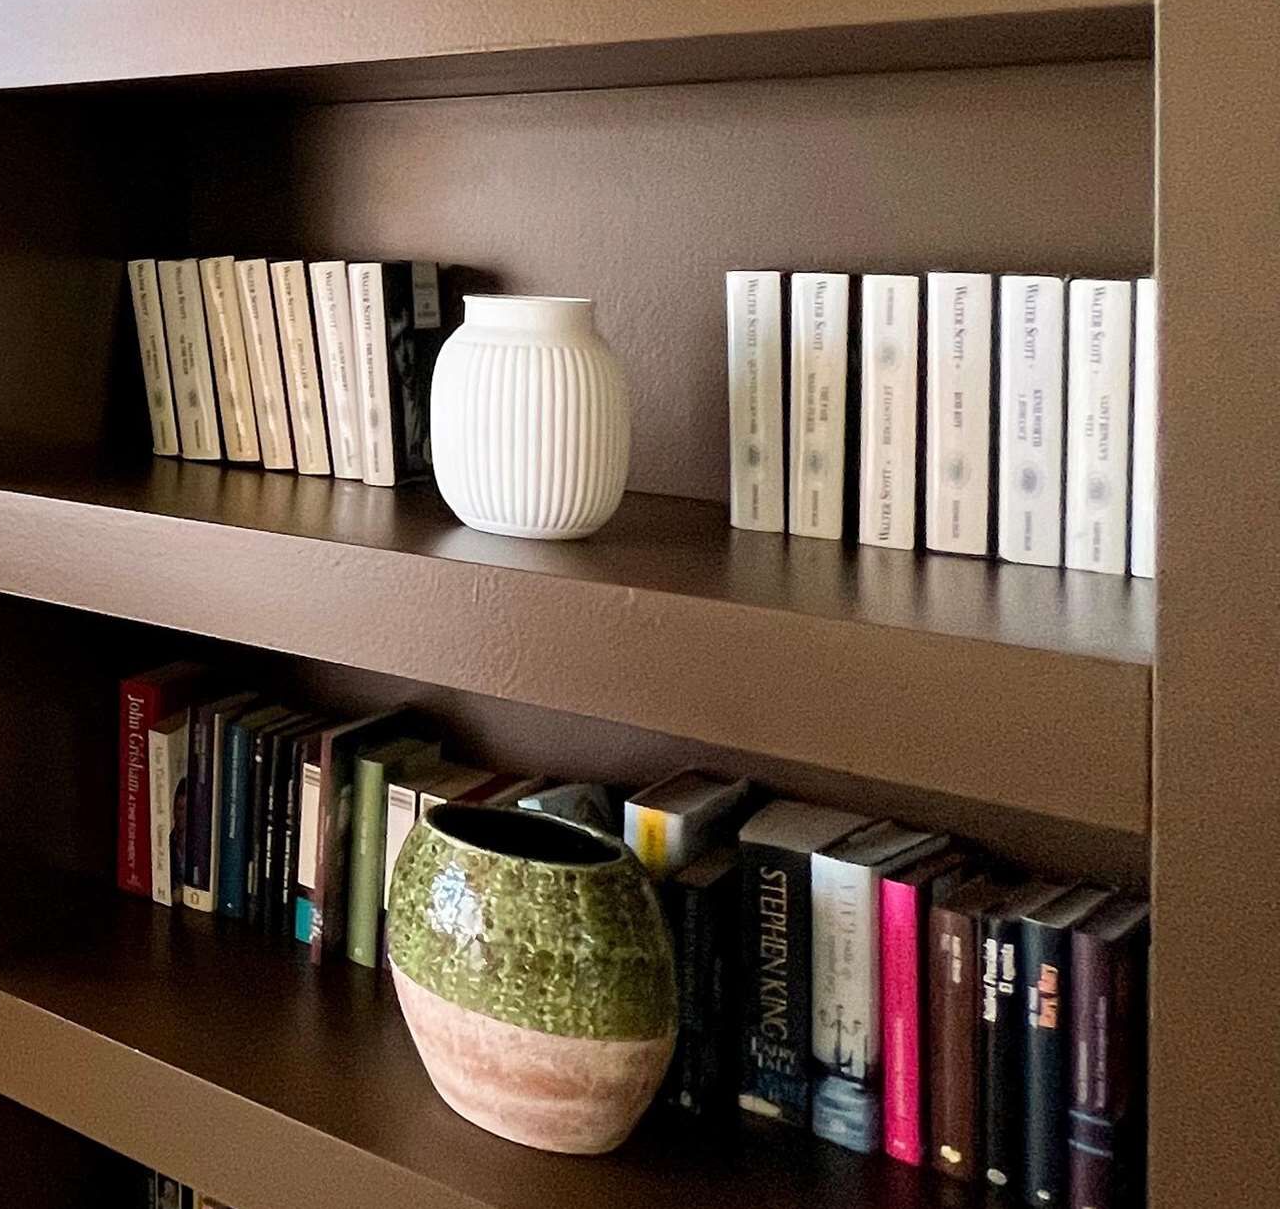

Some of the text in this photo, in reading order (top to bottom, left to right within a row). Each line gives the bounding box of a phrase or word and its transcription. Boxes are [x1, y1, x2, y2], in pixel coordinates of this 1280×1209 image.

[126, 694, 145, 792] John Grisham
[758, 866, 789, 1041] STEPHEN KING
